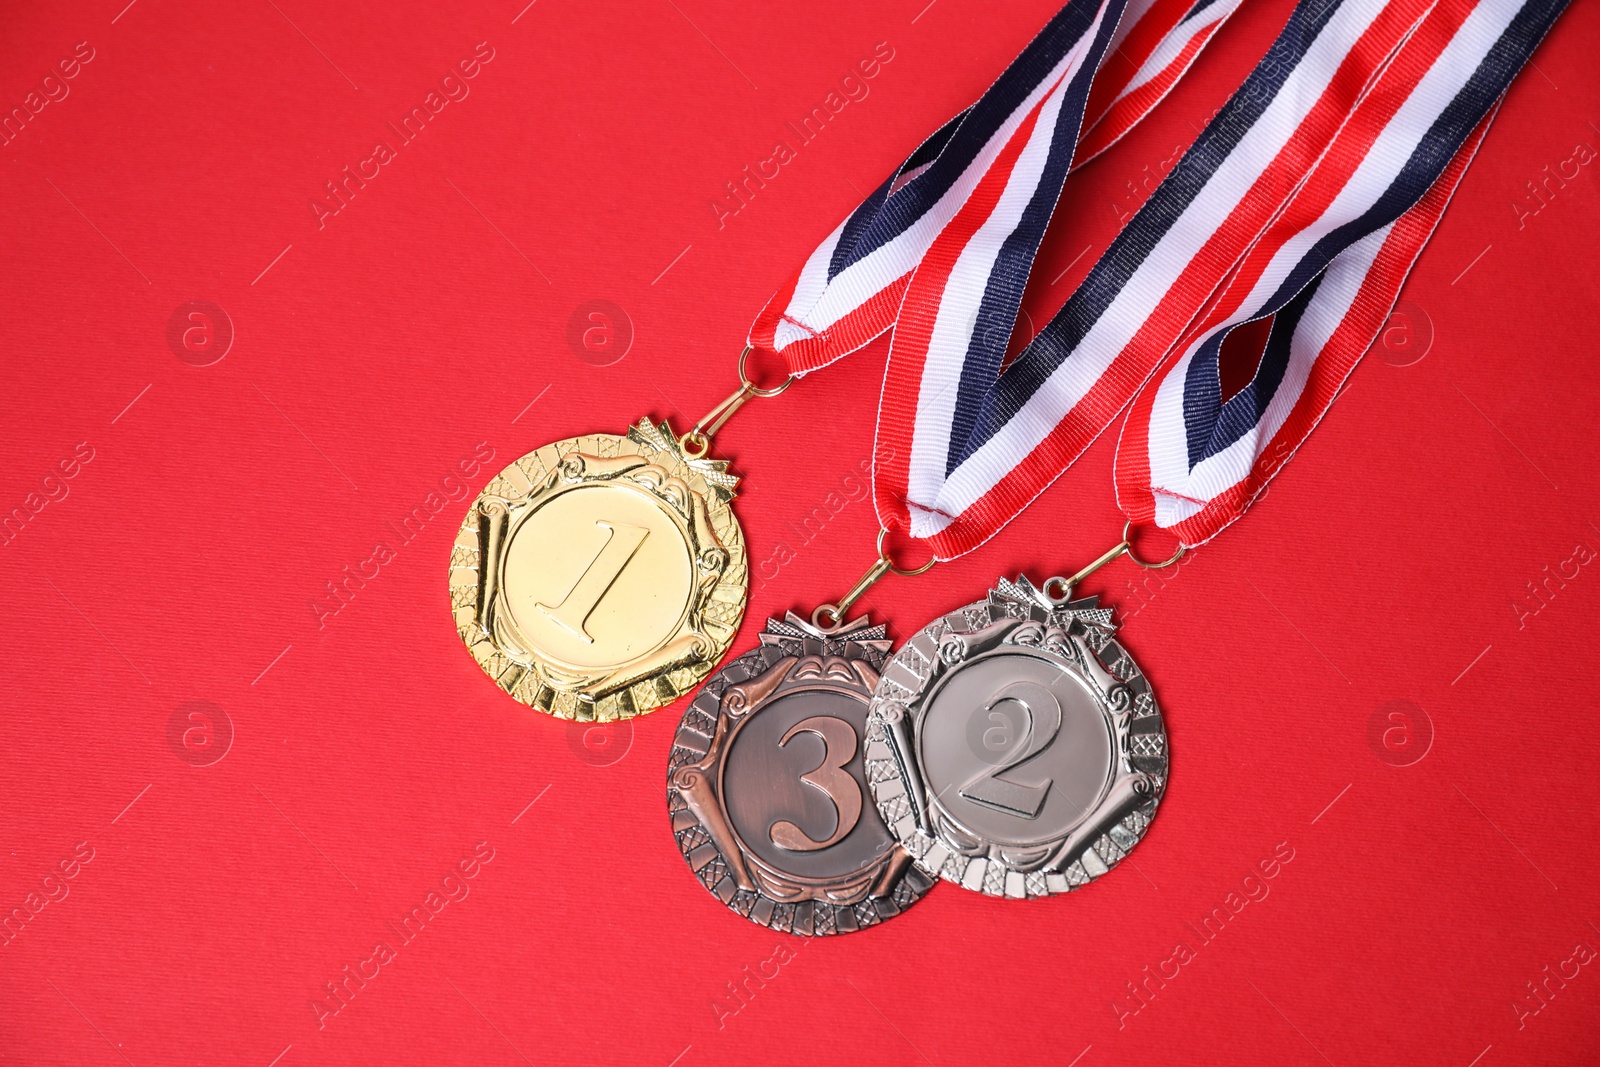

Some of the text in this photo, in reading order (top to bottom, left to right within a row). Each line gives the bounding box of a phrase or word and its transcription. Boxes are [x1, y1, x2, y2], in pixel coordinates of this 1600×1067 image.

[534, 519, 650, 644] 1
[769, 715, 863, 851] 3
[958, 680, 1062, 820] 2
